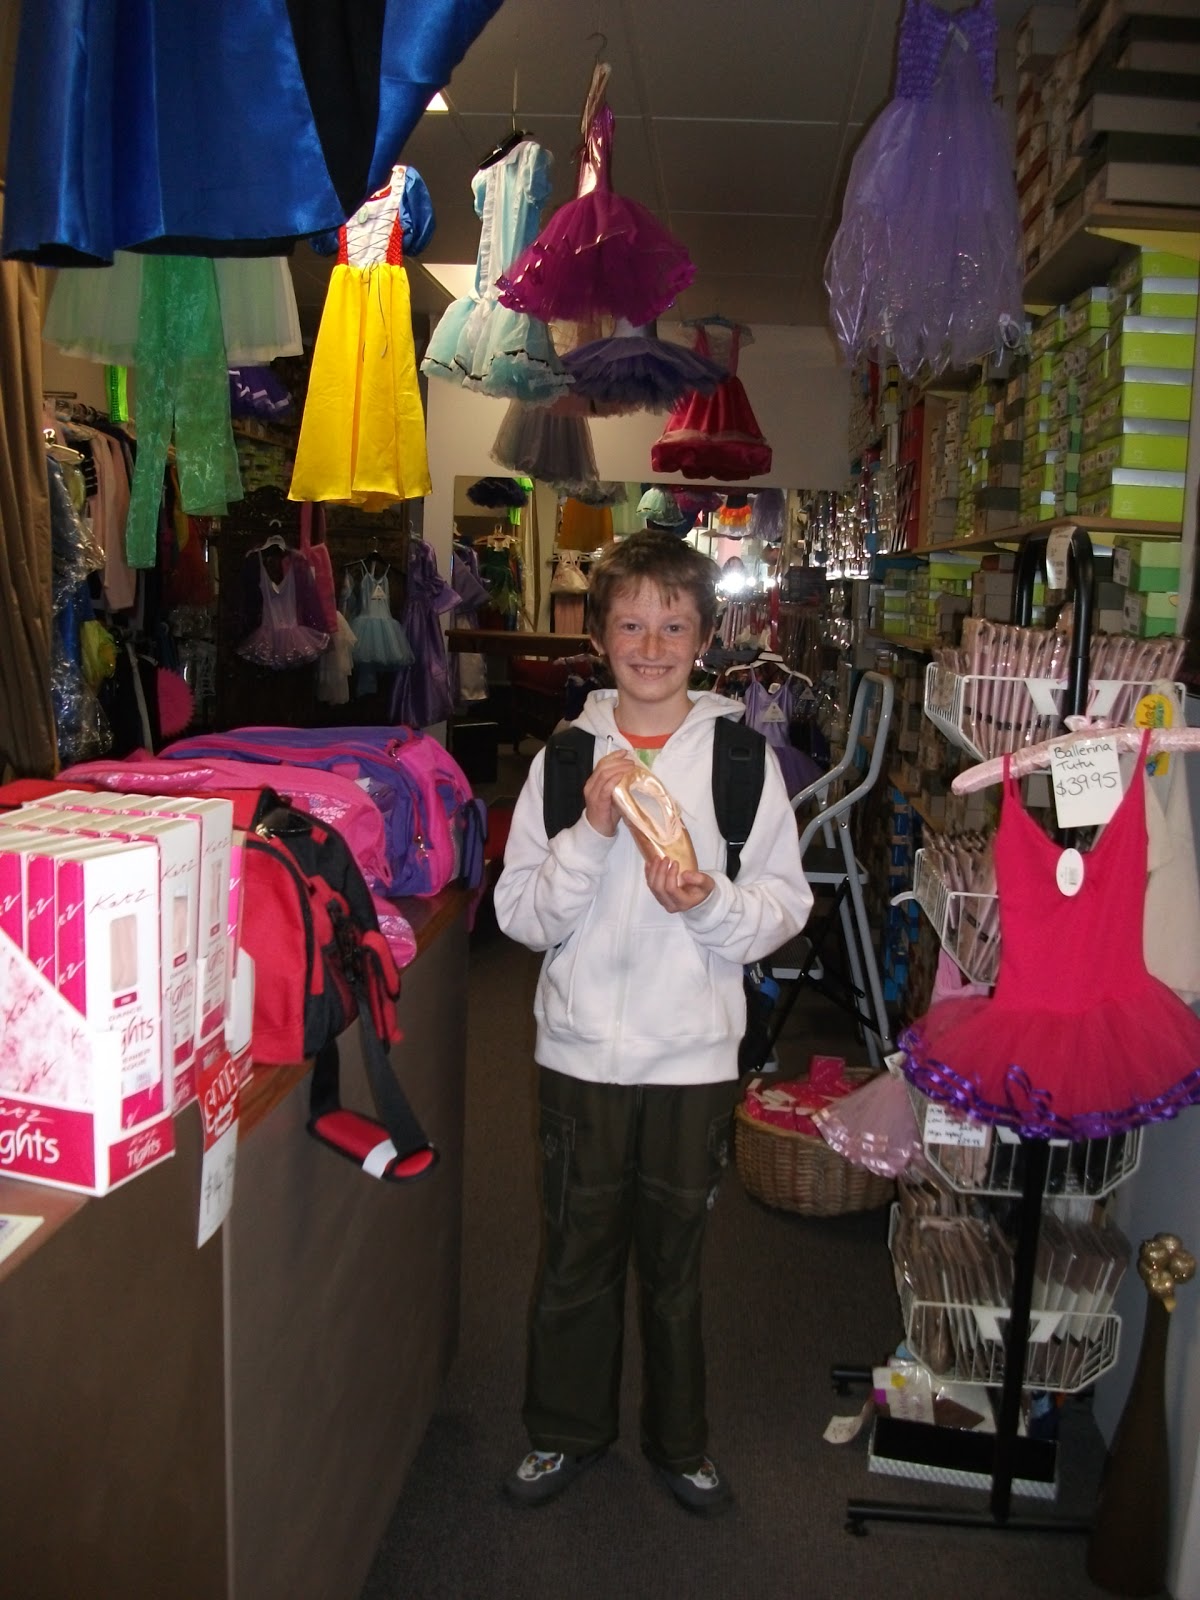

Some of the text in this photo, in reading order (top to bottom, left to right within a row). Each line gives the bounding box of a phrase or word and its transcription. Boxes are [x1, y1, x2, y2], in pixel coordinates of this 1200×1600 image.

[1054, 743, 1112, 759] Ballerina
[1056, 759, 1095, 771] Tutu
[89, 888, 154, 915] Katz
[0, 1122, 60, 1164] ghts
[127, 1137, 162, 1169] Tights
